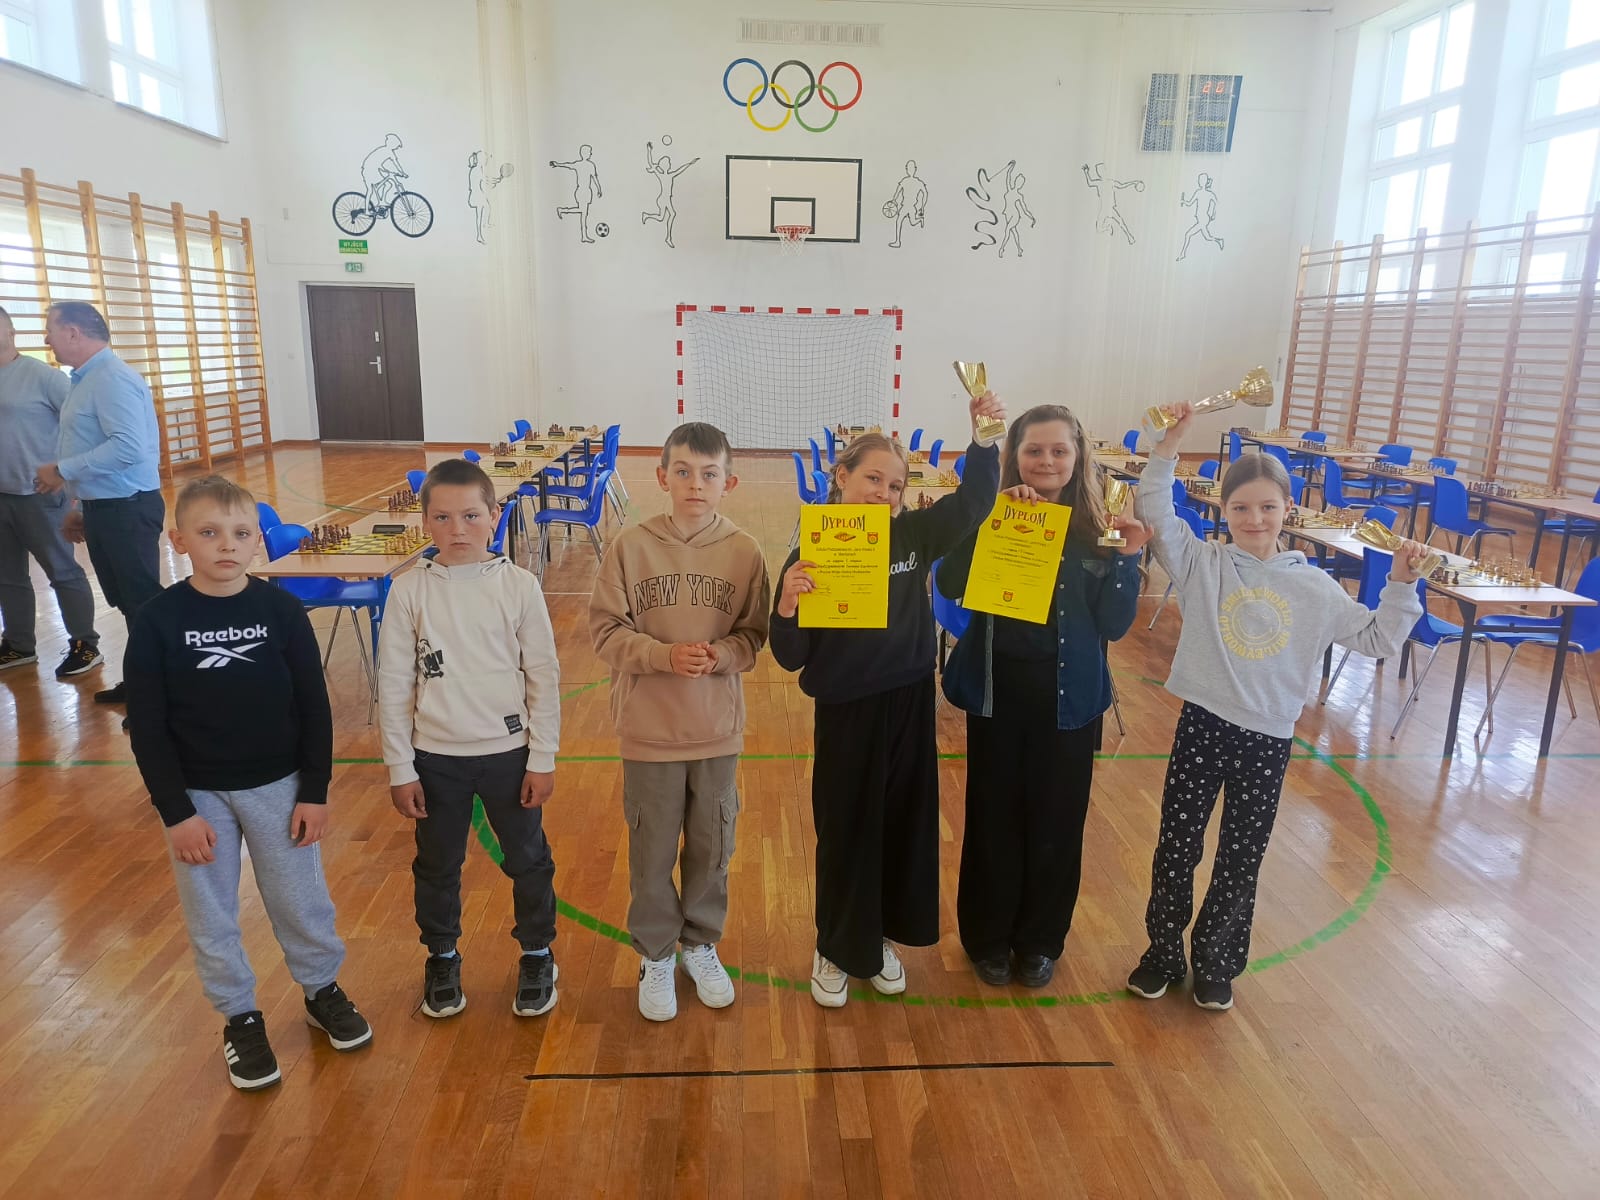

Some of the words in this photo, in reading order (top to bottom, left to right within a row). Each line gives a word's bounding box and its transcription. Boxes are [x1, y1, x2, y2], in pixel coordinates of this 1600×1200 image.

[822, 514, 865, 532] DYPLOM
[1003, 505, 1047, 528] DYPLOM
[889, 552, 918, 575] and
[634, 573, 681, 616] NEW
[686, 573, 736, 616] YORK
[184, 623, 268, 647] Reebok
